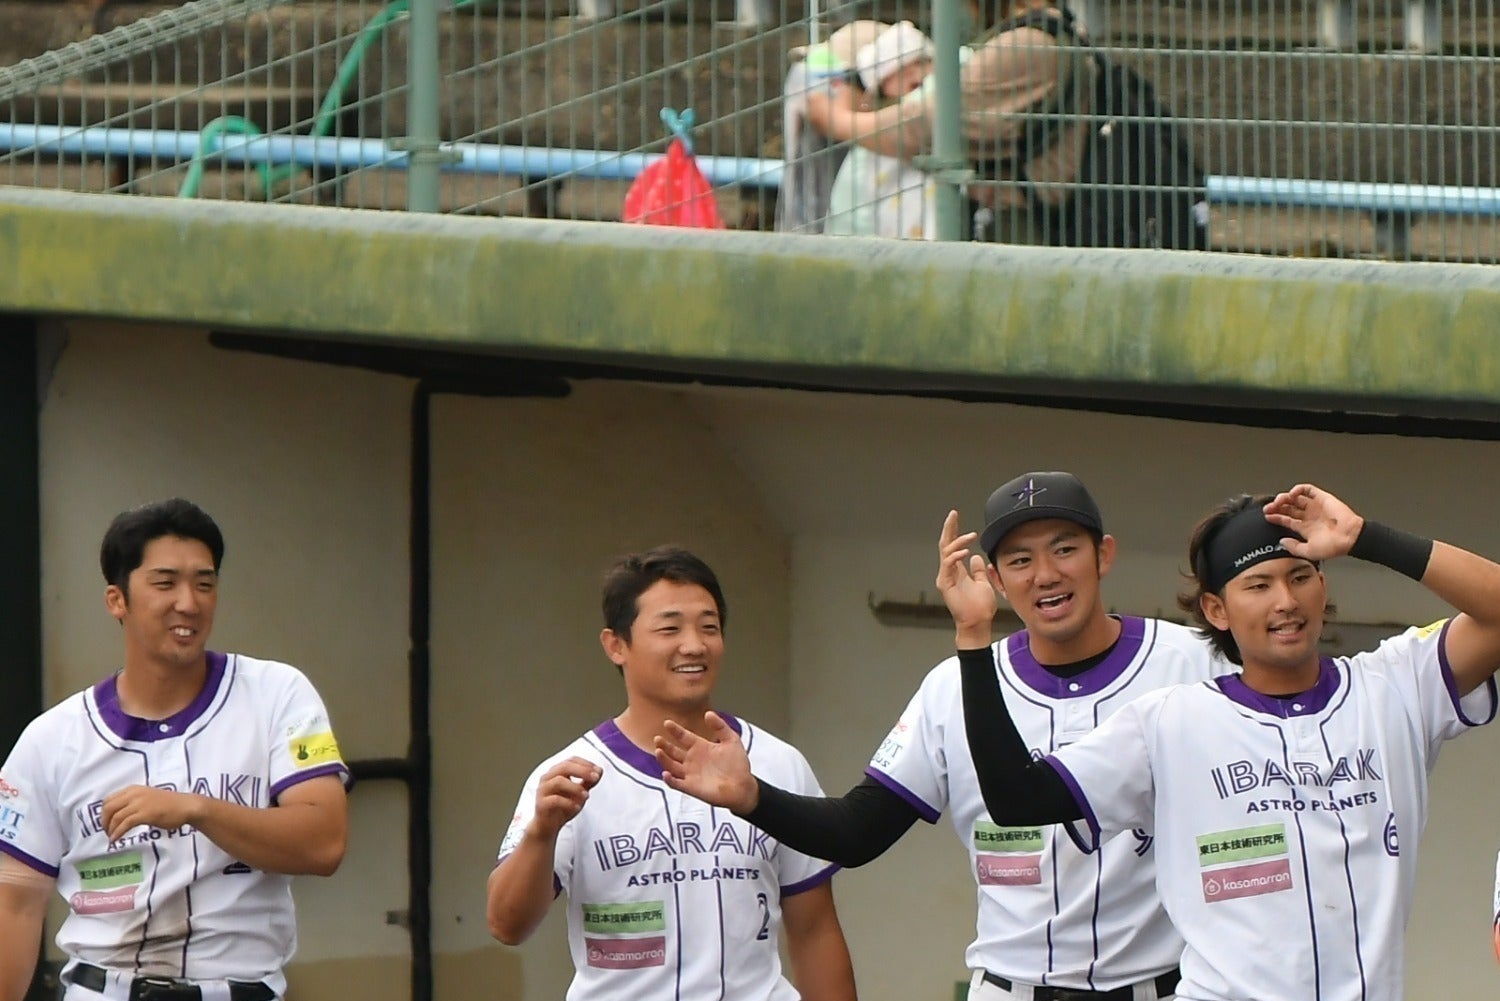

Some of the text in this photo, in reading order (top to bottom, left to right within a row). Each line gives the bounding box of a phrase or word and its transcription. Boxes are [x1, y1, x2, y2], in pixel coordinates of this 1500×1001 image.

[1234, 545, 1274, 568] MAHALO
[1211, 749, 1383, 800] IBARAK
[1246, 791, 1378, 814] ASTRO PLANETS
[107, 829, 162, 852] ASTRO
[1200, 832, 1285, 856] 東日本技術研究所
[627, 867, 760, 888] ASTRO PLANETS
[1222, 871, 1291, 891] kasamarron
[756, 892, 771, 941] 2
